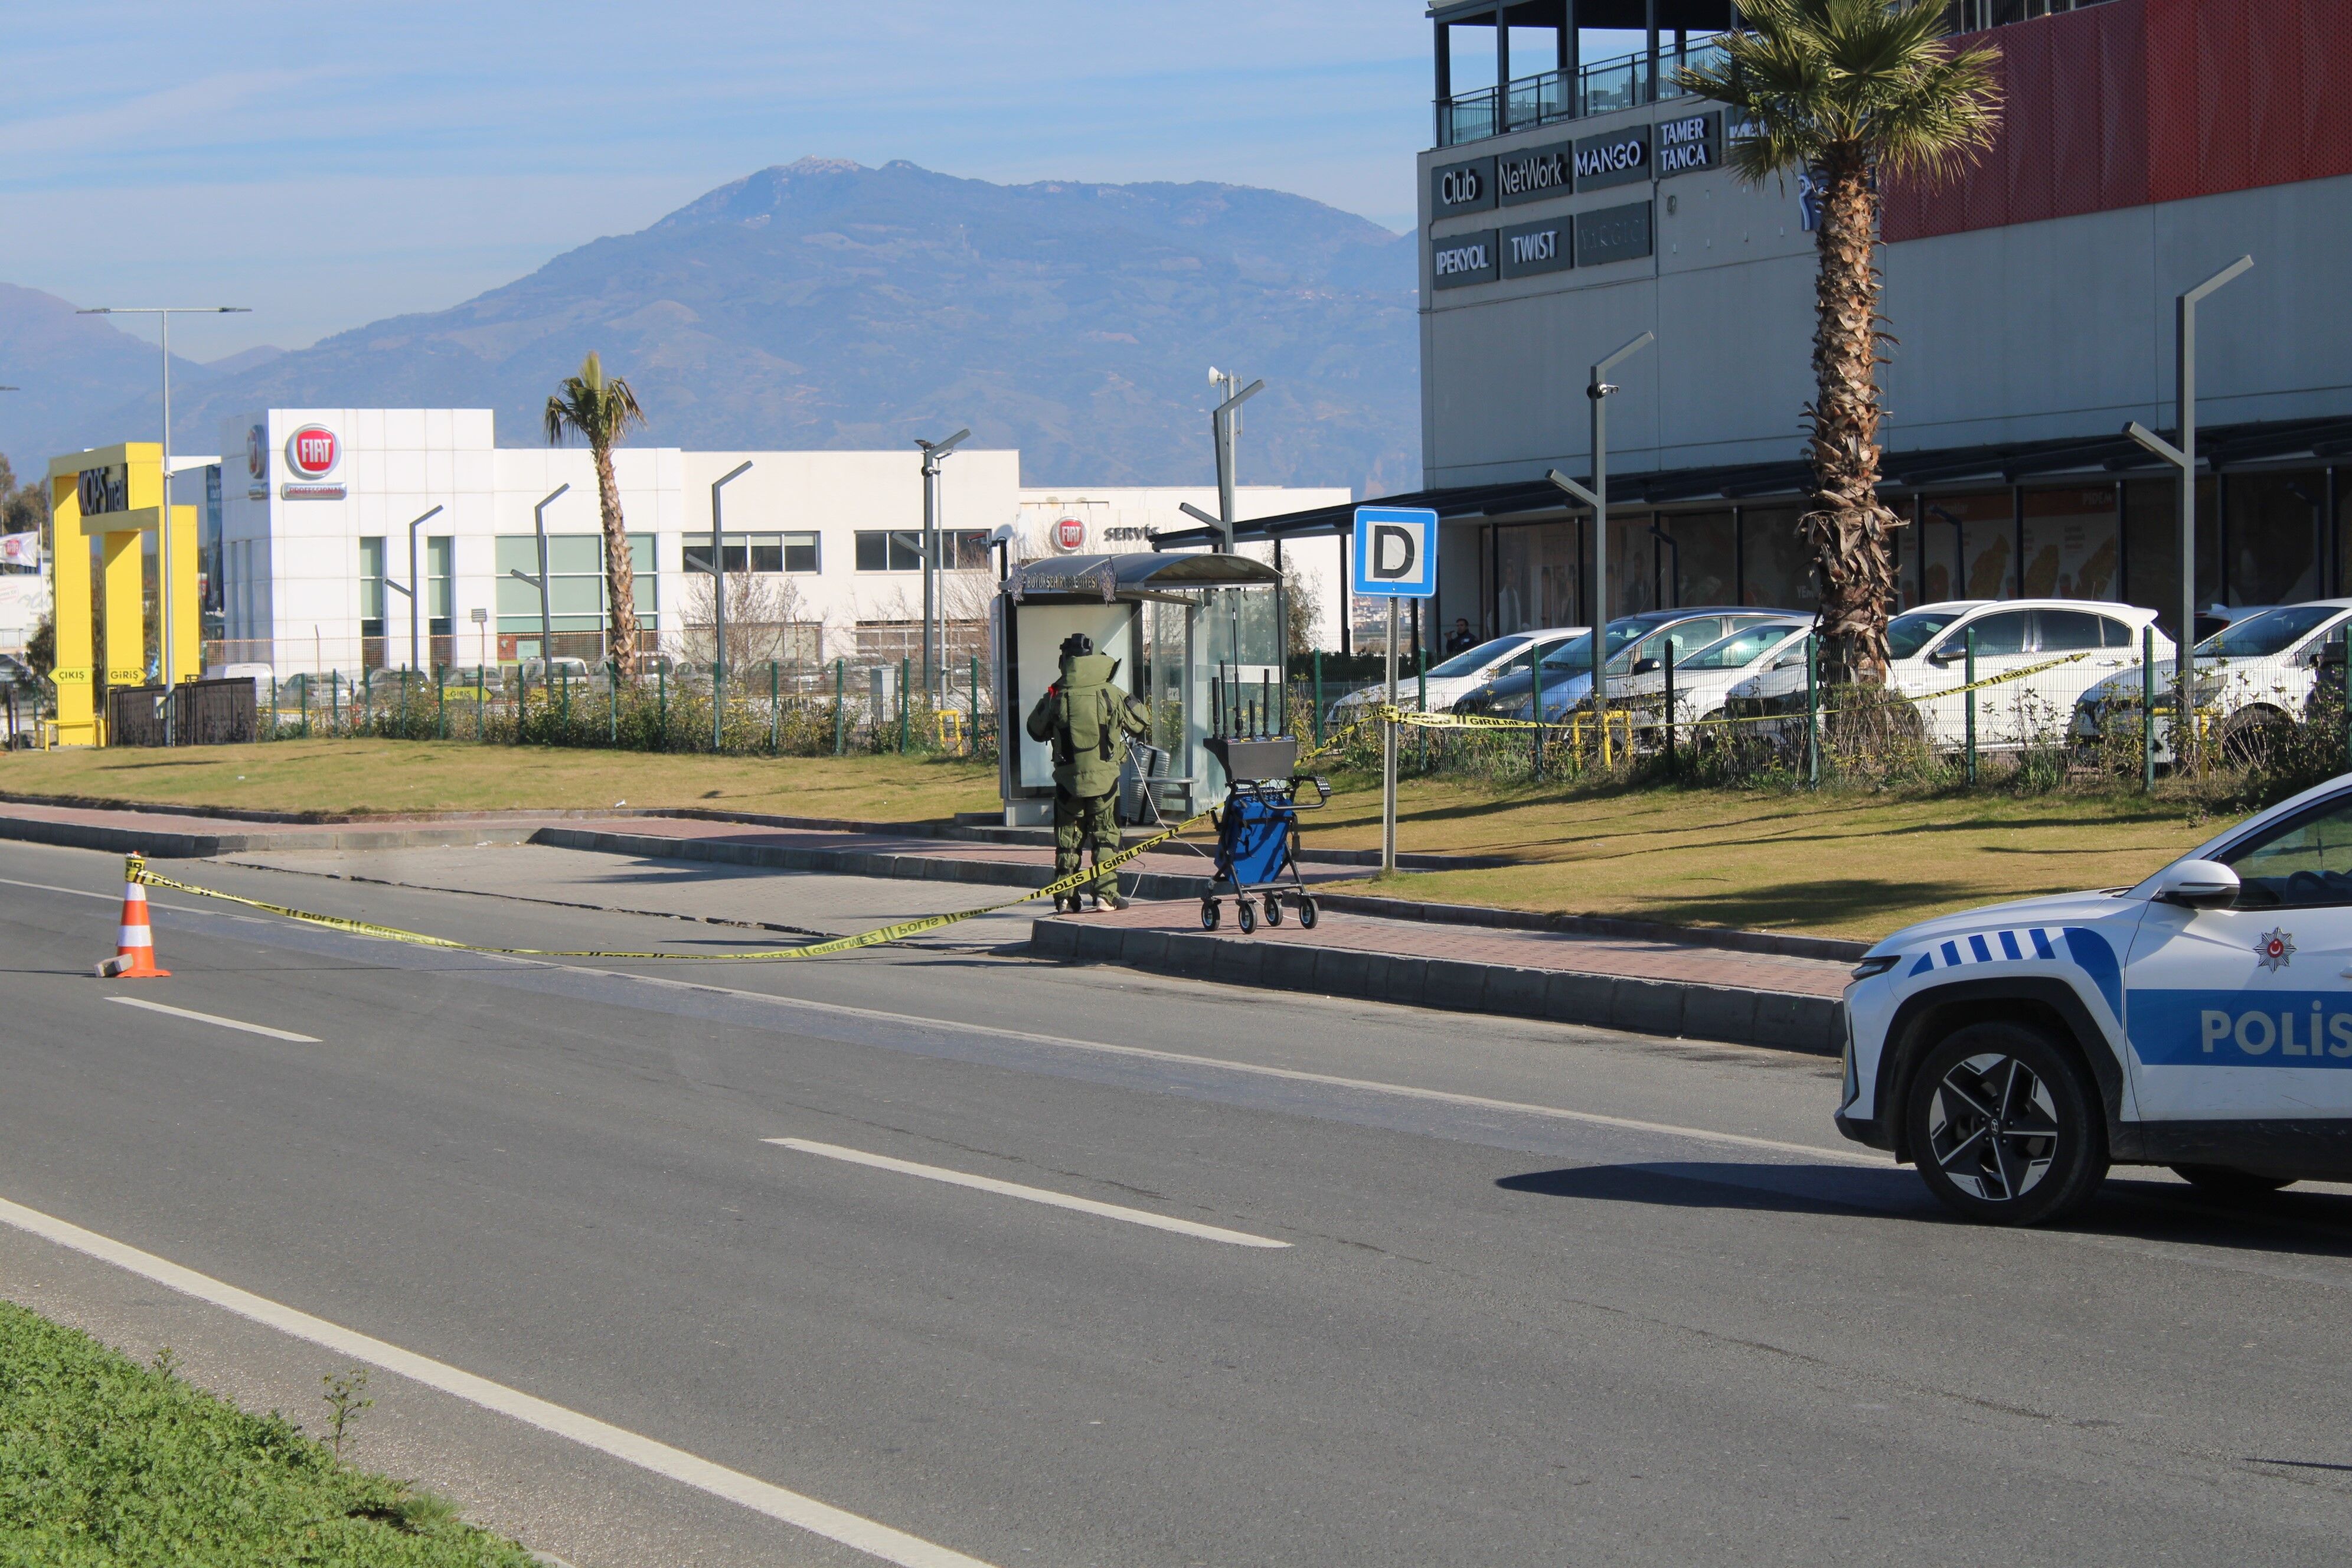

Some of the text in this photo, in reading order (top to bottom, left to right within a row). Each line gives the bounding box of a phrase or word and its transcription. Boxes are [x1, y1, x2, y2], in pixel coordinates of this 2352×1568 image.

[1661, 118, 1703, 145] TAMER
[1576, 141, 1641, 177] MANGO
[1661, 144, 1706, 171] TANCA
[1442, 169, 1476, 204] Club
[1500, 153, 1562, 195] NetWork
[1436, 245, 1489, 275] IPEKYOL
[1511, 231, 1557, 264] TWIST
[301, 439, 331, 463] FIAT
[1062, 525, 1081, 543] FIAT
[1374, 525, 1415, 579] D
[58, 671, 84, 681] ÇIKIŞ
